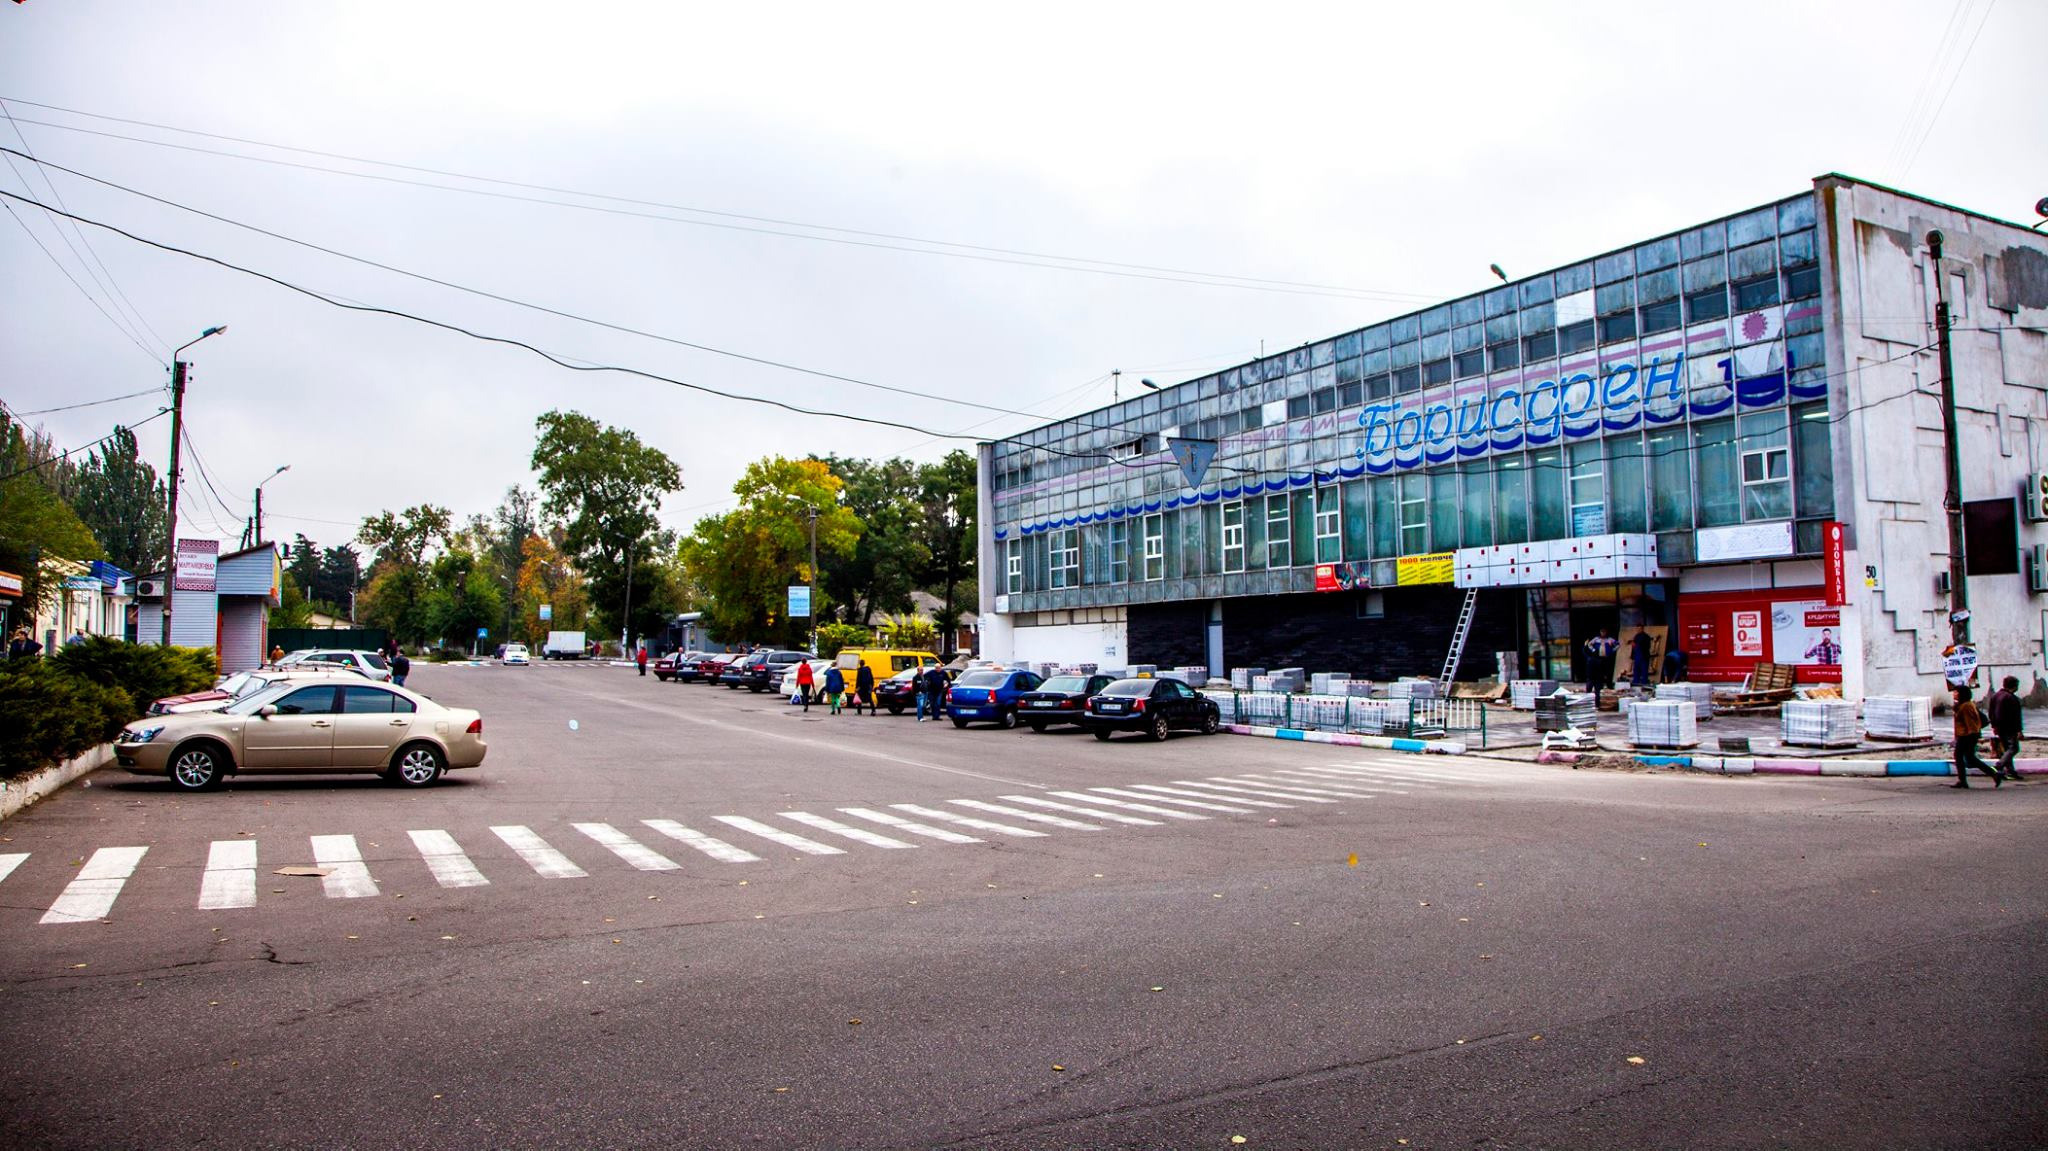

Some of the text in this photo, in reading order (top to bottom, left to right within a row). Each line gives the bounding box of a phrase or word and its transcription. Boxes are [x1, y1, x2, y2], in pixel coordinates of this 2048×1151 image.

[1357, 352, 1686, 461] Борисфен
[1833, 542, 1842, 602] ЛОМБАРД
[1865, 565, 1877, 578] 50
